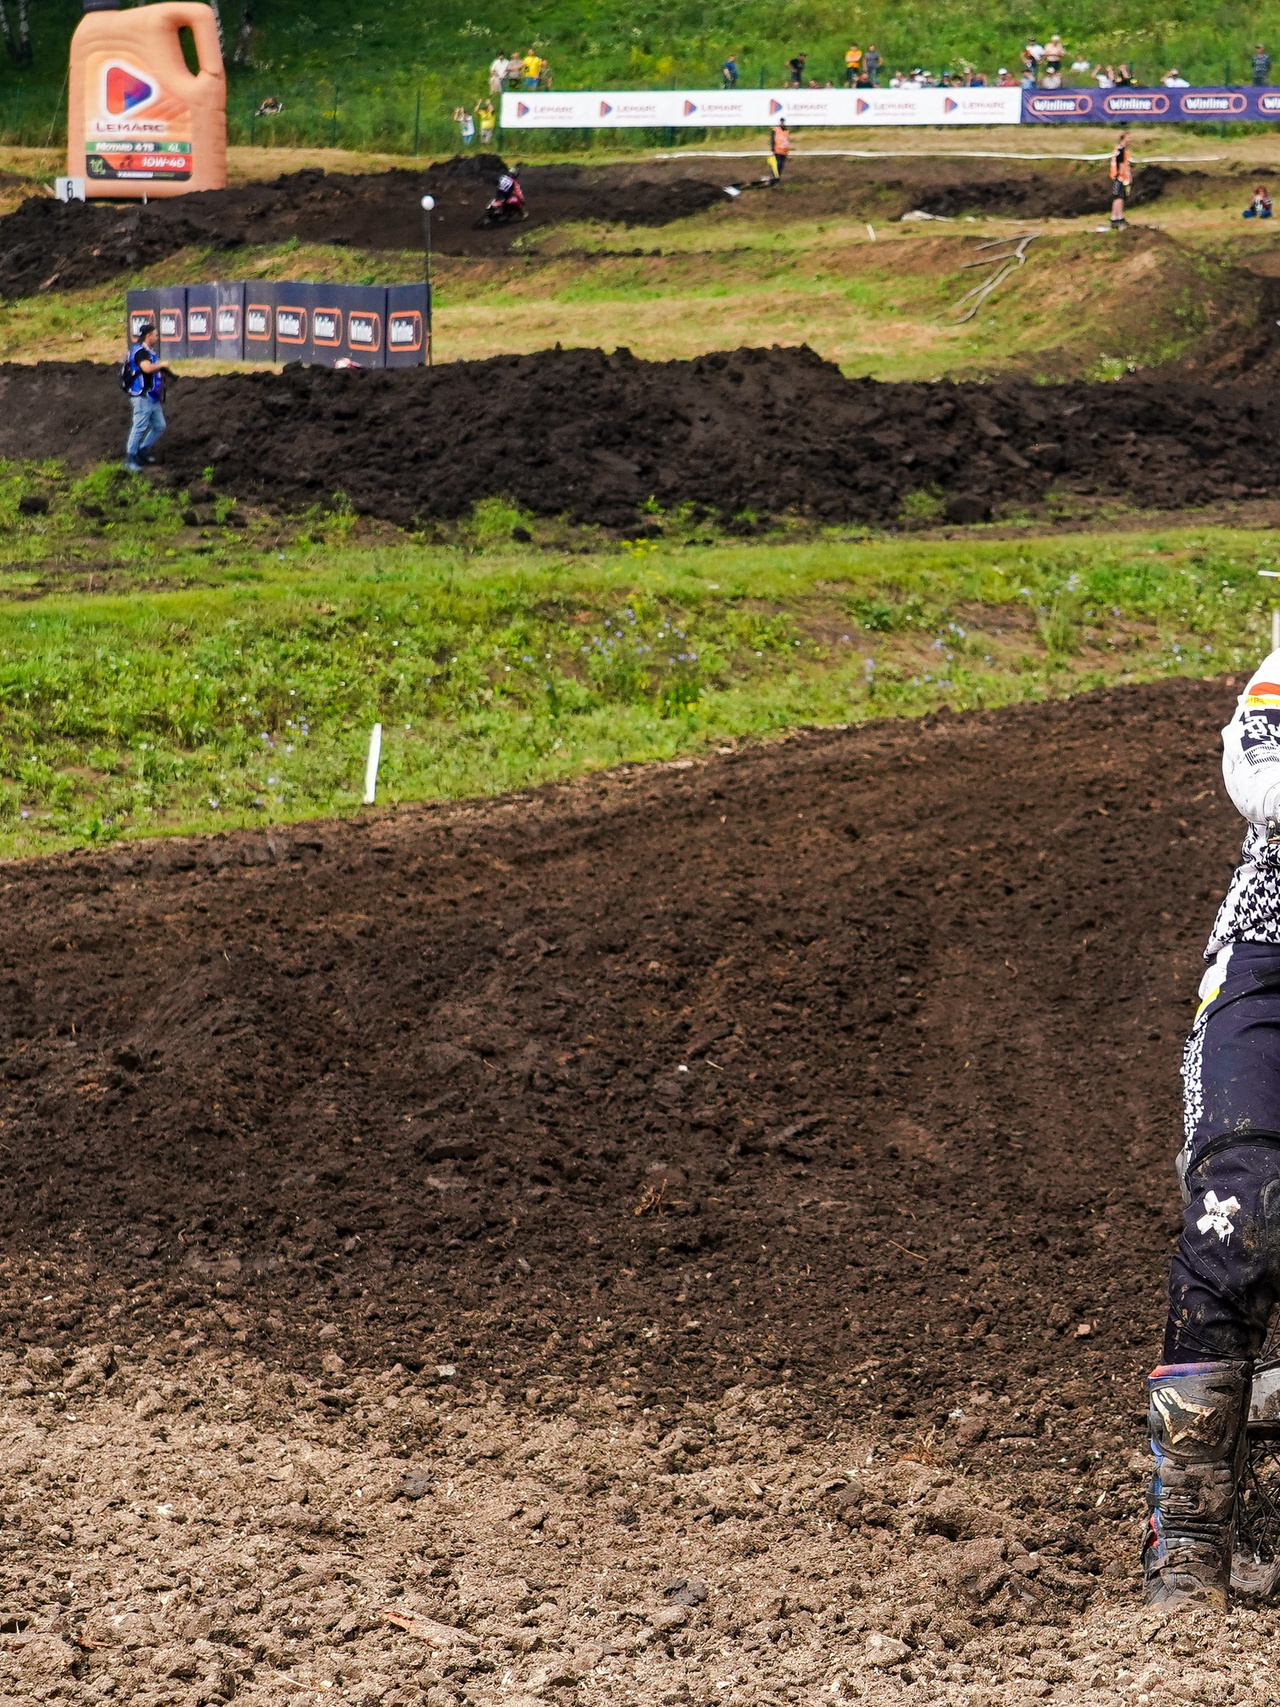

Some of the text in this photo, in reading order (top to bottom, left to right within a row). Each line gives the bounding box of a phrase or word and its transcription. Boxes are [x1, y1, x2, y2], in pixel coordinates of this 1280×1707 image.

[1033, 99, 1076, 112] Winline
[1109, 97, 1151, 111] Winline
[1185, 97, 1229, 110] Winline
[141, 157, 186, 169] 10W-40
[66, 181, 74, 199] 6
